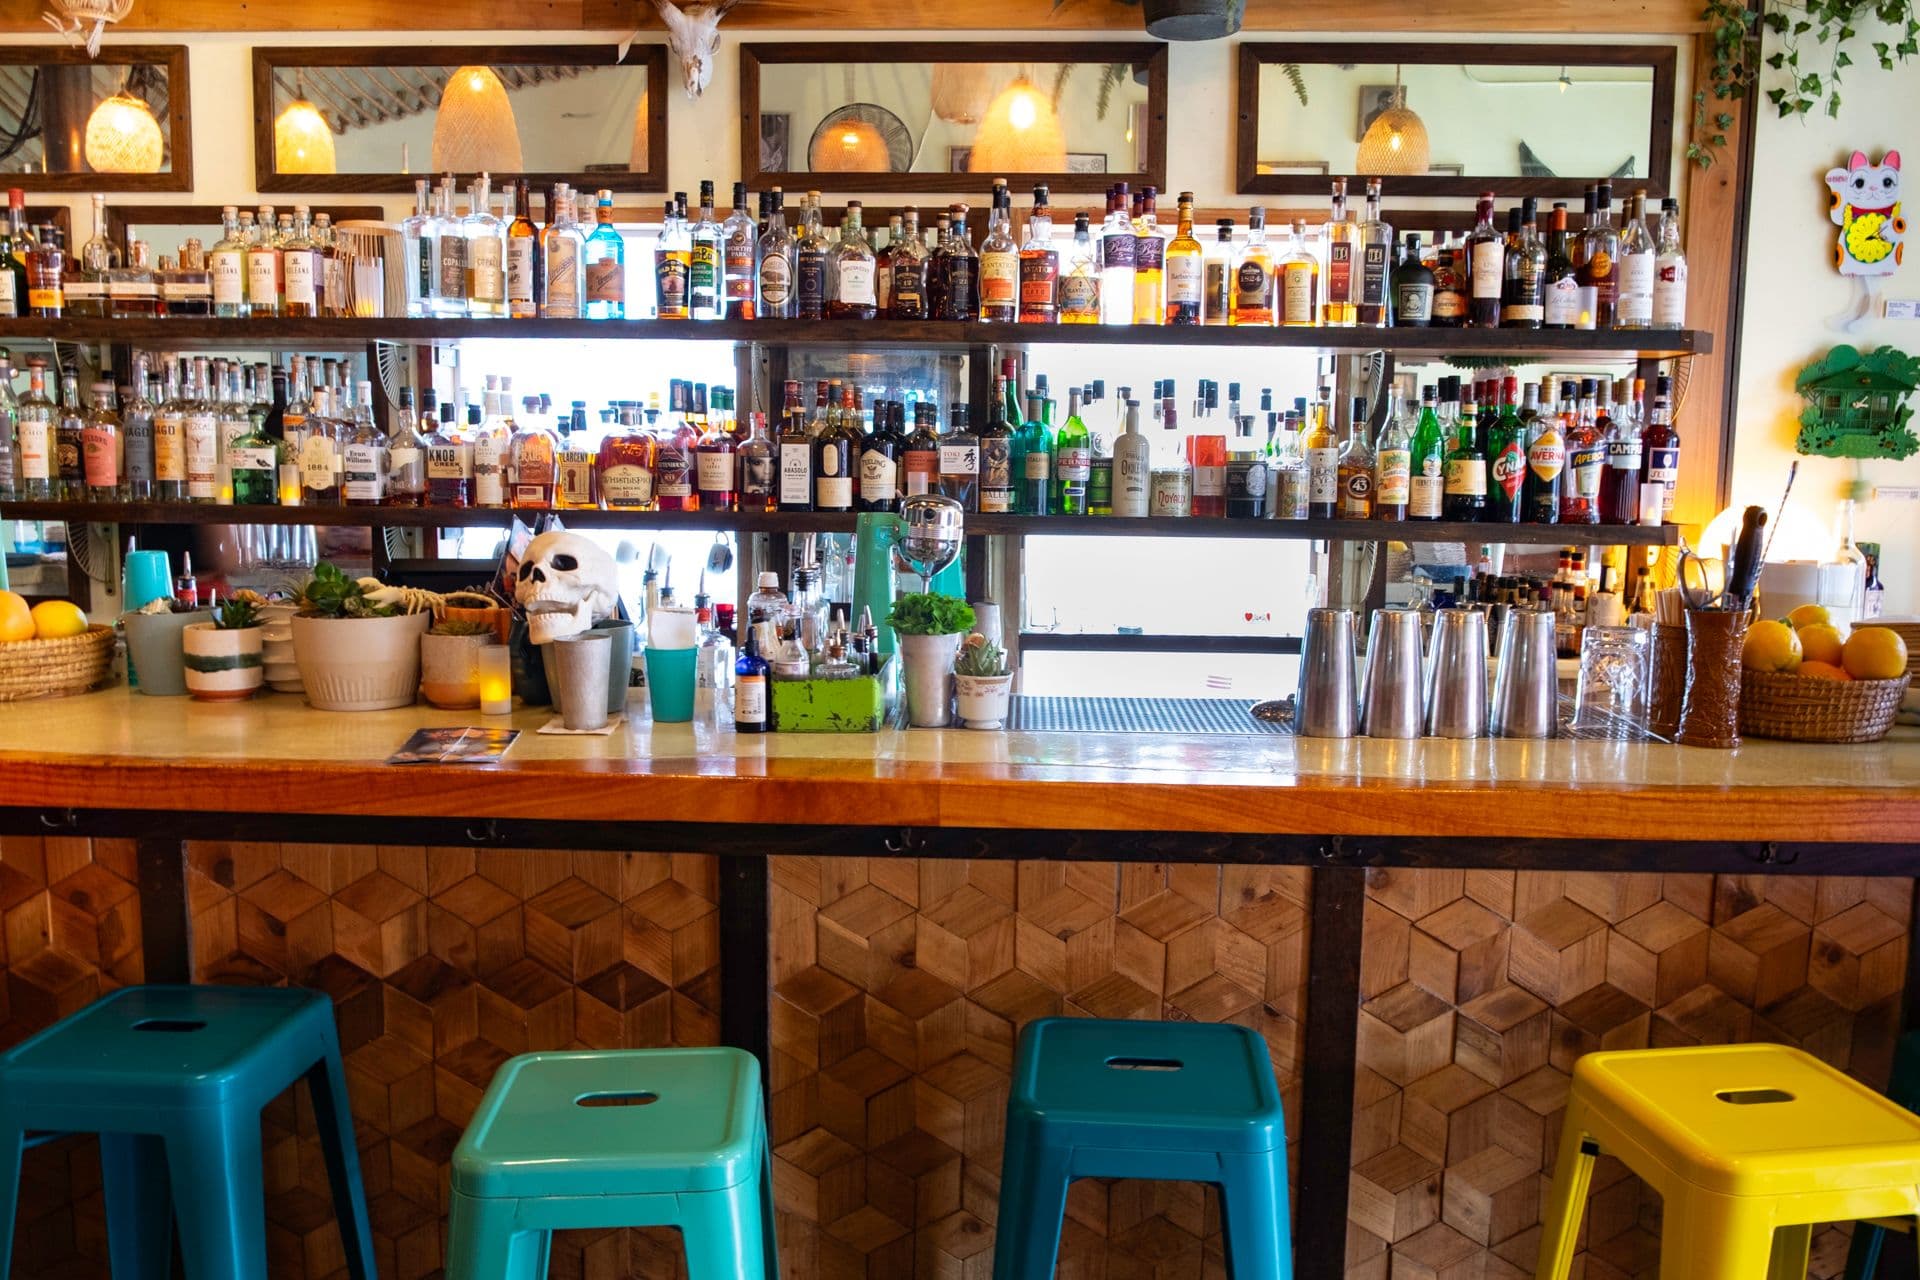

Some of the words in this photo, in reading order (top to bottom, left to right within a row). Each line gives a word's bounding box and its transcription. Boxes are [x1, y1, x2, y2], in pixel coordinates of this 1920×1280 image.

[1240, 275, 1262, 283] 1824
[429, 450, 455, 462] KNOB
[1530, 451, 1564, 460] AVERNA
[307, 463, 328, 471] 1884
[861, 459, 887, 468] TEELING
[1352, 480, 1367, 491] 43
